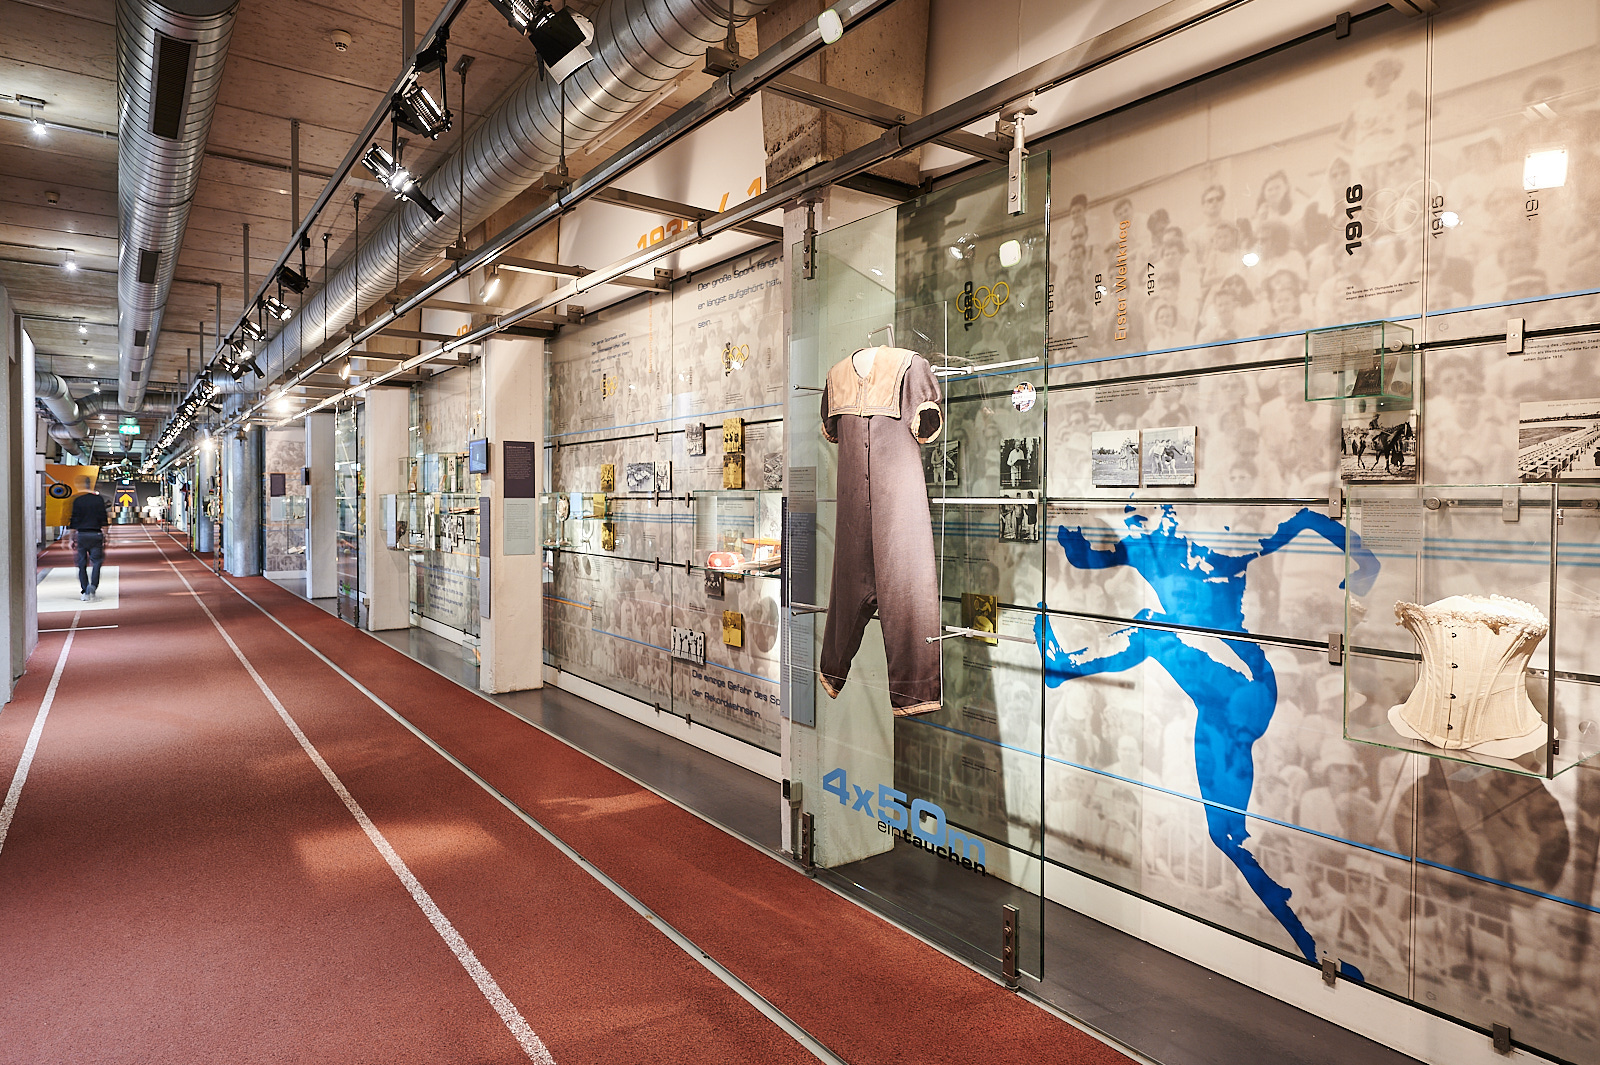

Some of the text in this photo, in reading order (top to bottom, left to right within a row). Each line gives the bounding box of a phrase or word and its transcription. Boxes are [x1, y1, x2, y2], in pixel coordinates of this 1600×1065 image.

[1346, 184, 1363, 256] 1916
[1432, 195, 1444, 239] 1915
[698, 282, 710, 291] Der
[712, 274, 732, 288] große
[734, 265, 755, 279] Sport
[698, 302, 705, 310] er
[707, 295, 727, 307] längst
[728, 283, 764, 300] aufgehört
[1115, 220, 1131, 341] Erster Weltkrieg
[1147, 262, 1155, 296] 1917
[692, 669, 702, 680] Die
[728, 681, 752, 695] Gefahr
[754, 691, 768, 701] des
[692, 689, 703, 697] der
[822, 767, 987, 866] 4x50m
[877, 819, 987, 877] eintauchen
